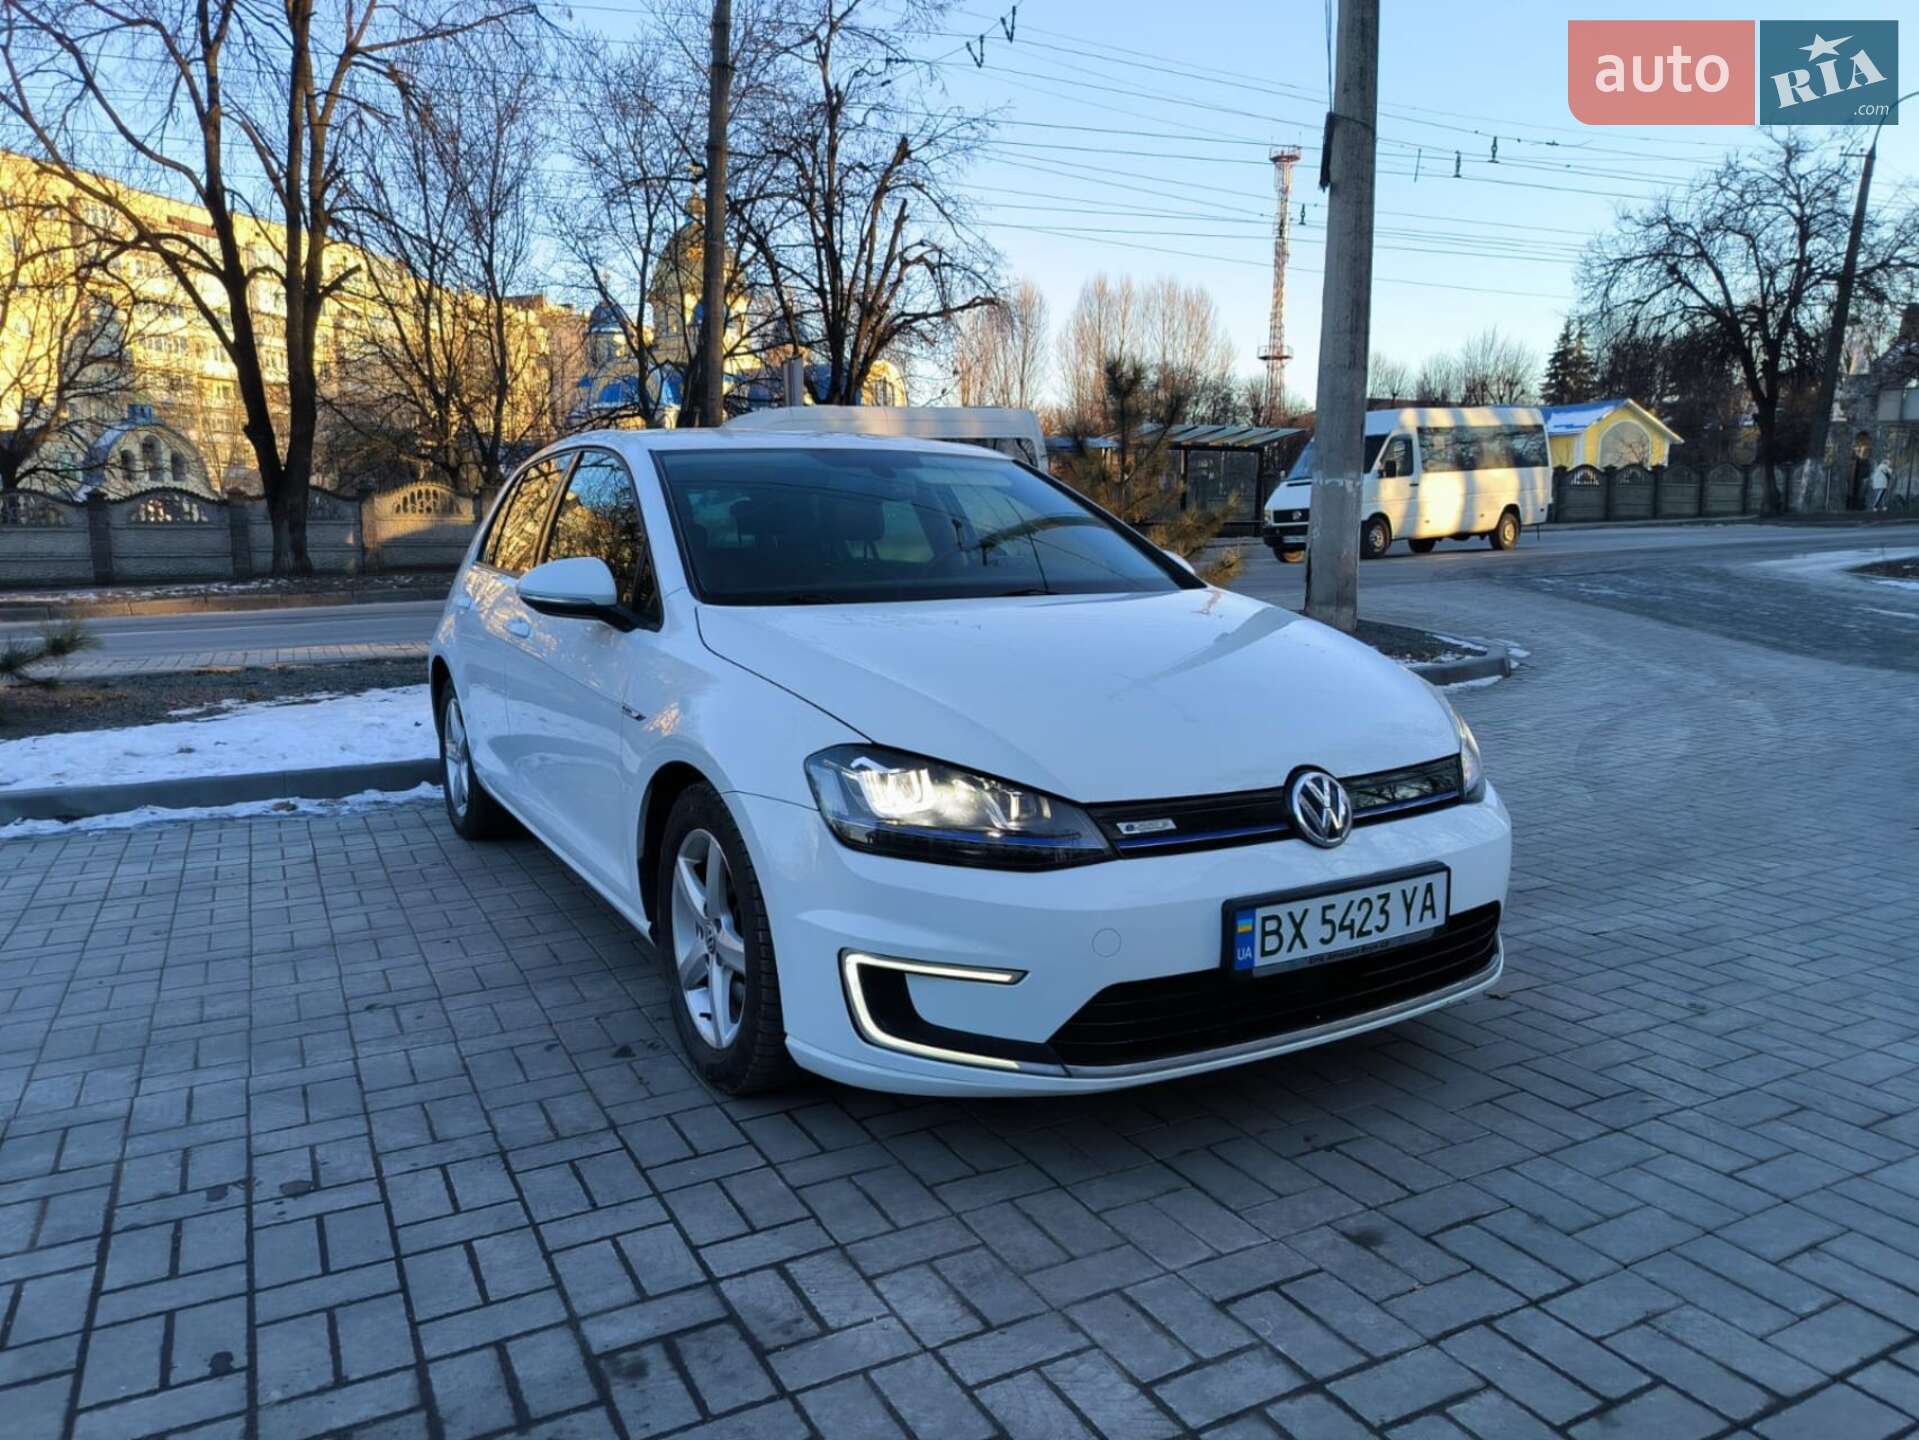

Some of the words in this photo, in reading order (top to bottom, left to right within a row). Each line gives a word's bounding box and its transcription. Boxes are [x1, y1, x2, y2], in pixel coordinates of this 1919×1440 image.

[1297, 775, 1346, 836] VW
[1260, 908, 1309, 957] BX
[1319, 892, 1392, 945] 5423
[1401, 881, 1437, 926] YA
[1237, 946, 1253, 961] UA
